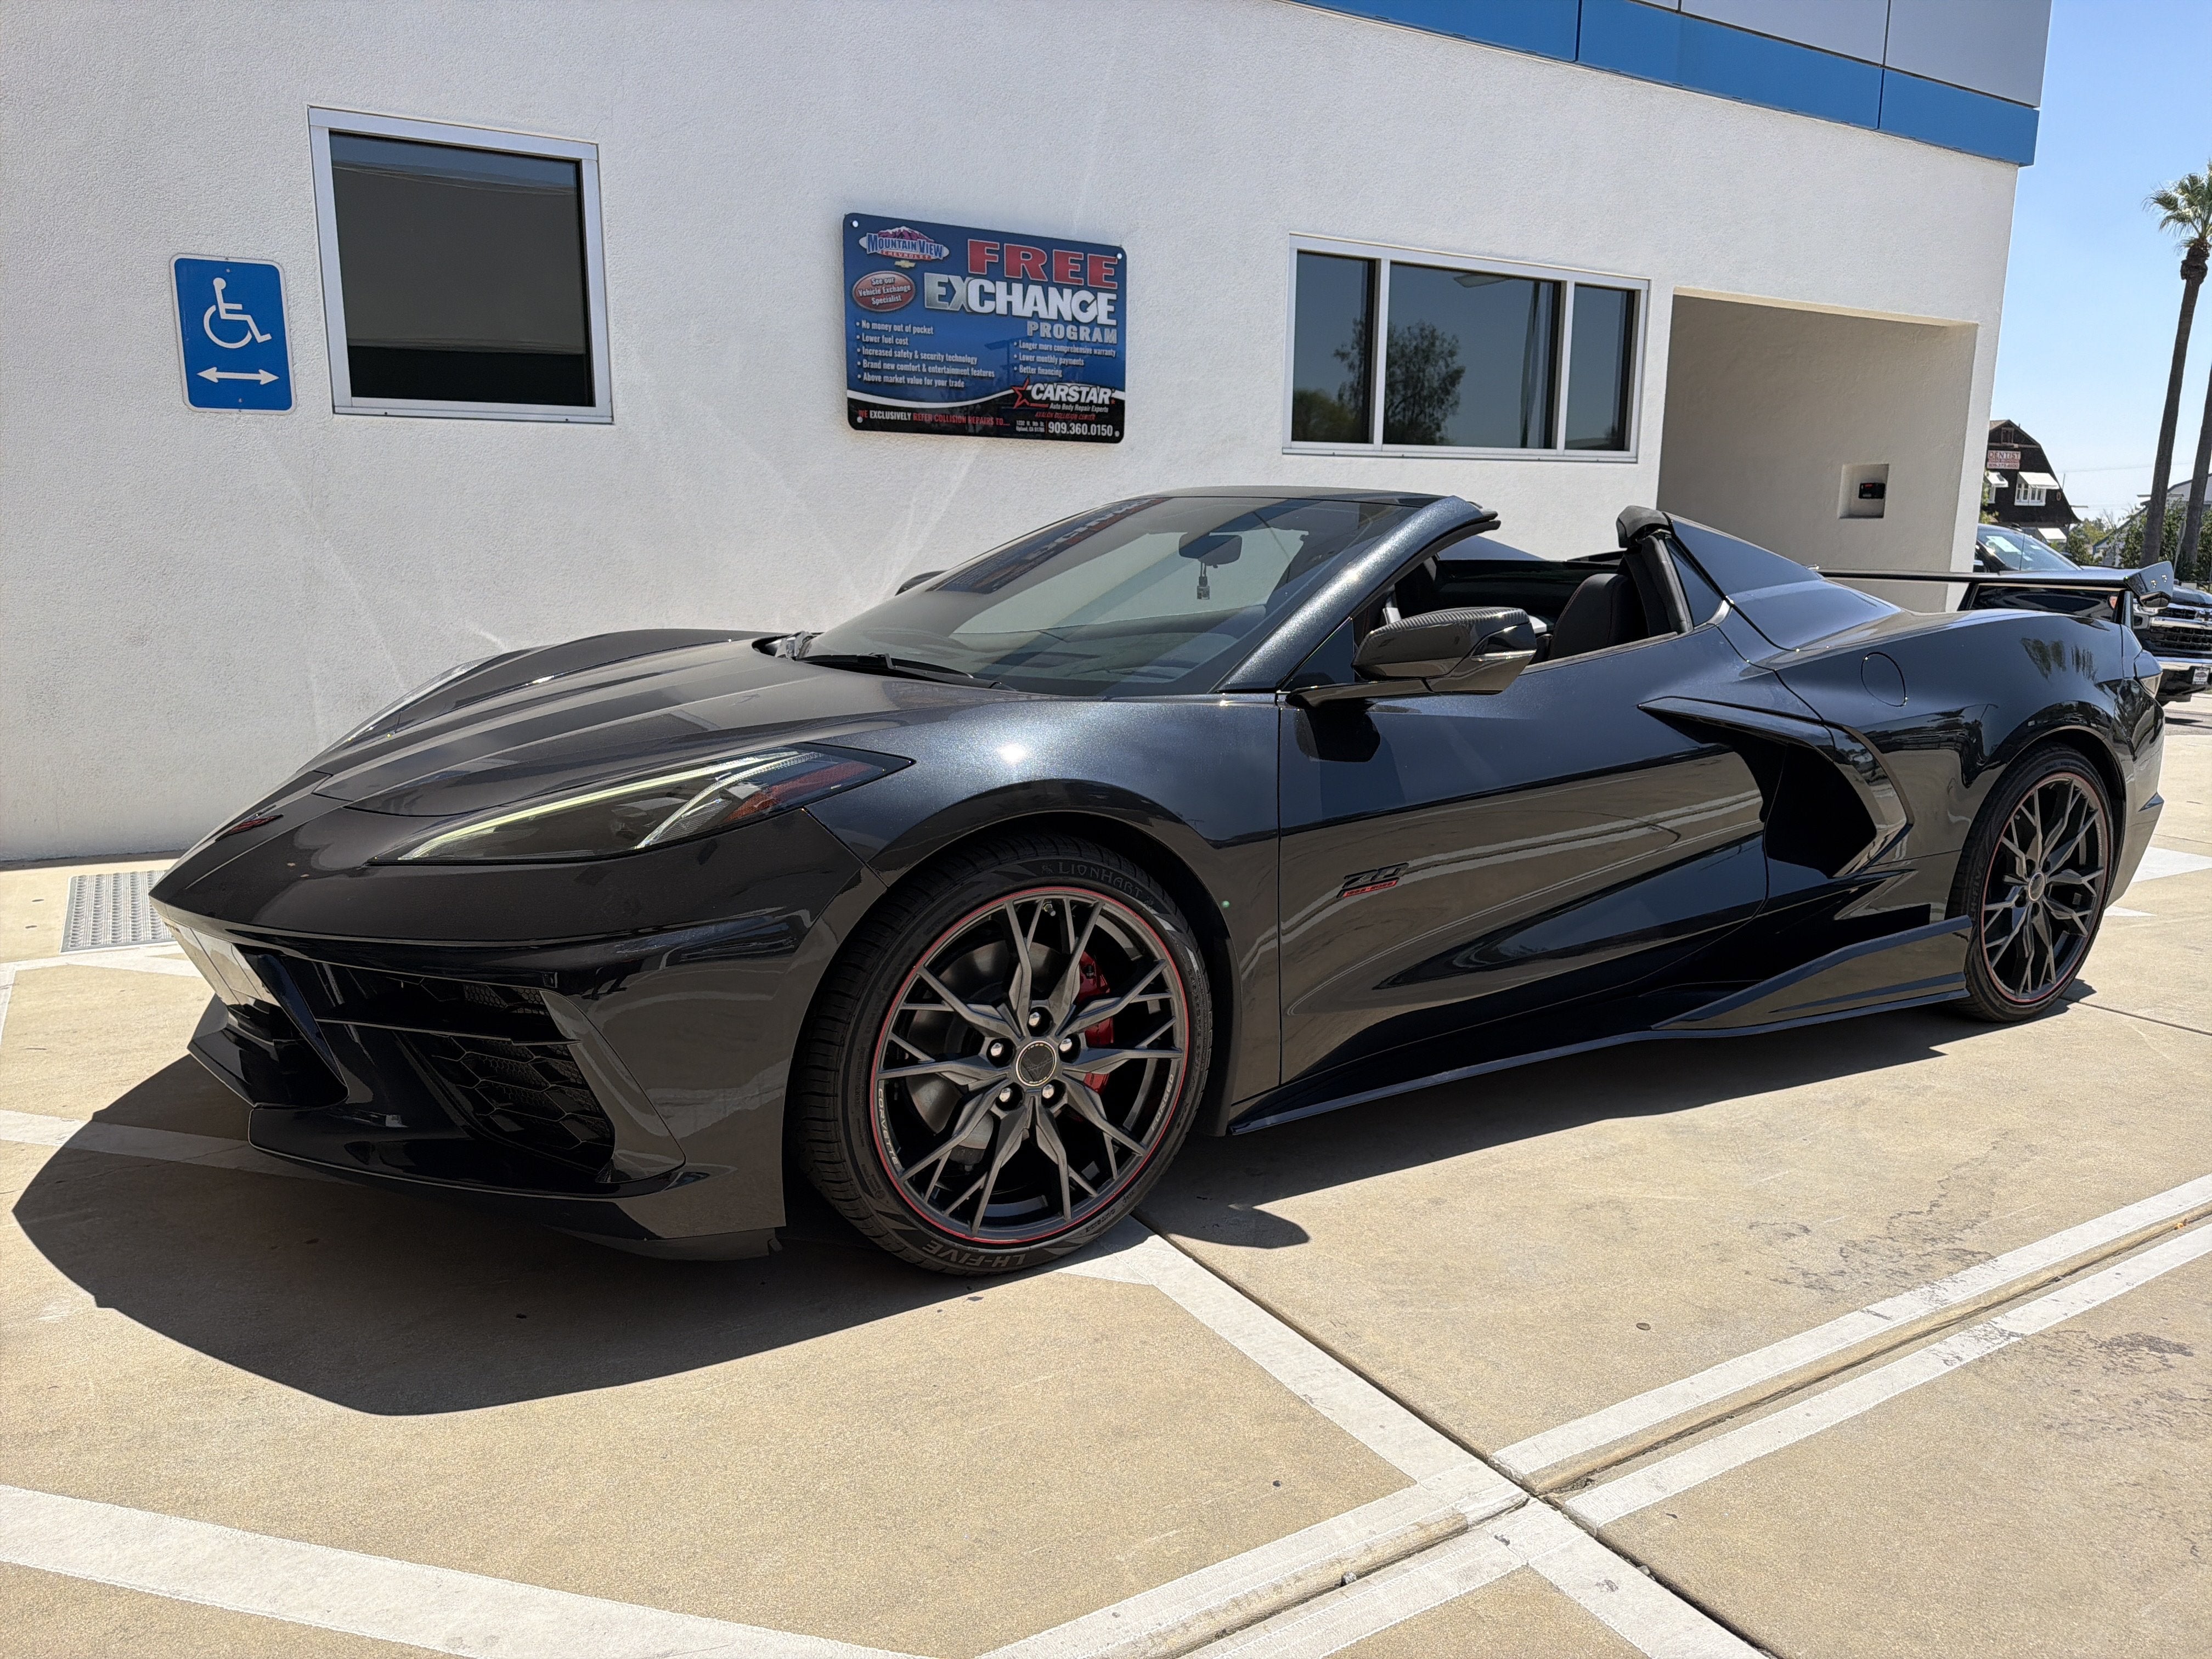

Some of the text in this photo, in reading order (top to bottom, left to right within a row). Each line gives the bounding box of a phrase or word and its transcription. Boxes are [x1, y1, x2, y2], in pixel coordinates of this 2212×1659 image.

[867, 233, 944, 259] MOUNTAIN VIEW
[882, 252, 931, 260] CHEVROLET
[968, 239, 1118, 289] FREE
[871, 278, 883, 286] See
[858, 285, 911, 297] Vehicle Exchange
[924, 273, 1117, 325] EXCHANGE
[871, 295, 902, 306] Specialist
[861, 319, 934, 335] No money out of pocket
[1027, 321, 1117, 344] PROGRAM
[862, 332, 909, 346] Lower fuel cost
[862, 346, 978, 365] Increased safety & security technology
[1019, 340, 1038, 351] Longer
[1053, 345, 1092, 354] comprehensive
[1093, 348, 1116, 358] warranty
[1019, 352, 1085, 366] Lower monthly payments
[862, 359, 882, 369] Brand
[896, 363, 921, 372] comfort
[922, 363, 927, 373] &
[928, 365, 970, 376] entertainment
[970, 367, 995, 377] features
[1019, 364, 1063, 378] Better financing
[863, 373, 964, 388] Above market value for your trade
[1031, 383, 1112, 405] CARSTAR
[1062, 403, 1074, 411] Body
[1074, 404, 1091, 413] Repair
[858, 410, 868, 419] WE
[870, 410, 912, 421] EXCLUSIVELY
[913, 413, 933, 421] REFER
[934, 414, 966, 424] COLLISION
[968, 416, 994, 425] REPAIRS
[1048, 421, 1114, 437] 909.360.0150
[1059, 862, 1143, 898] LIONHART
[878, 1088, 899, 1165] CORVETTE
[922, 1240, 1026, 1268] LH-FIVE
